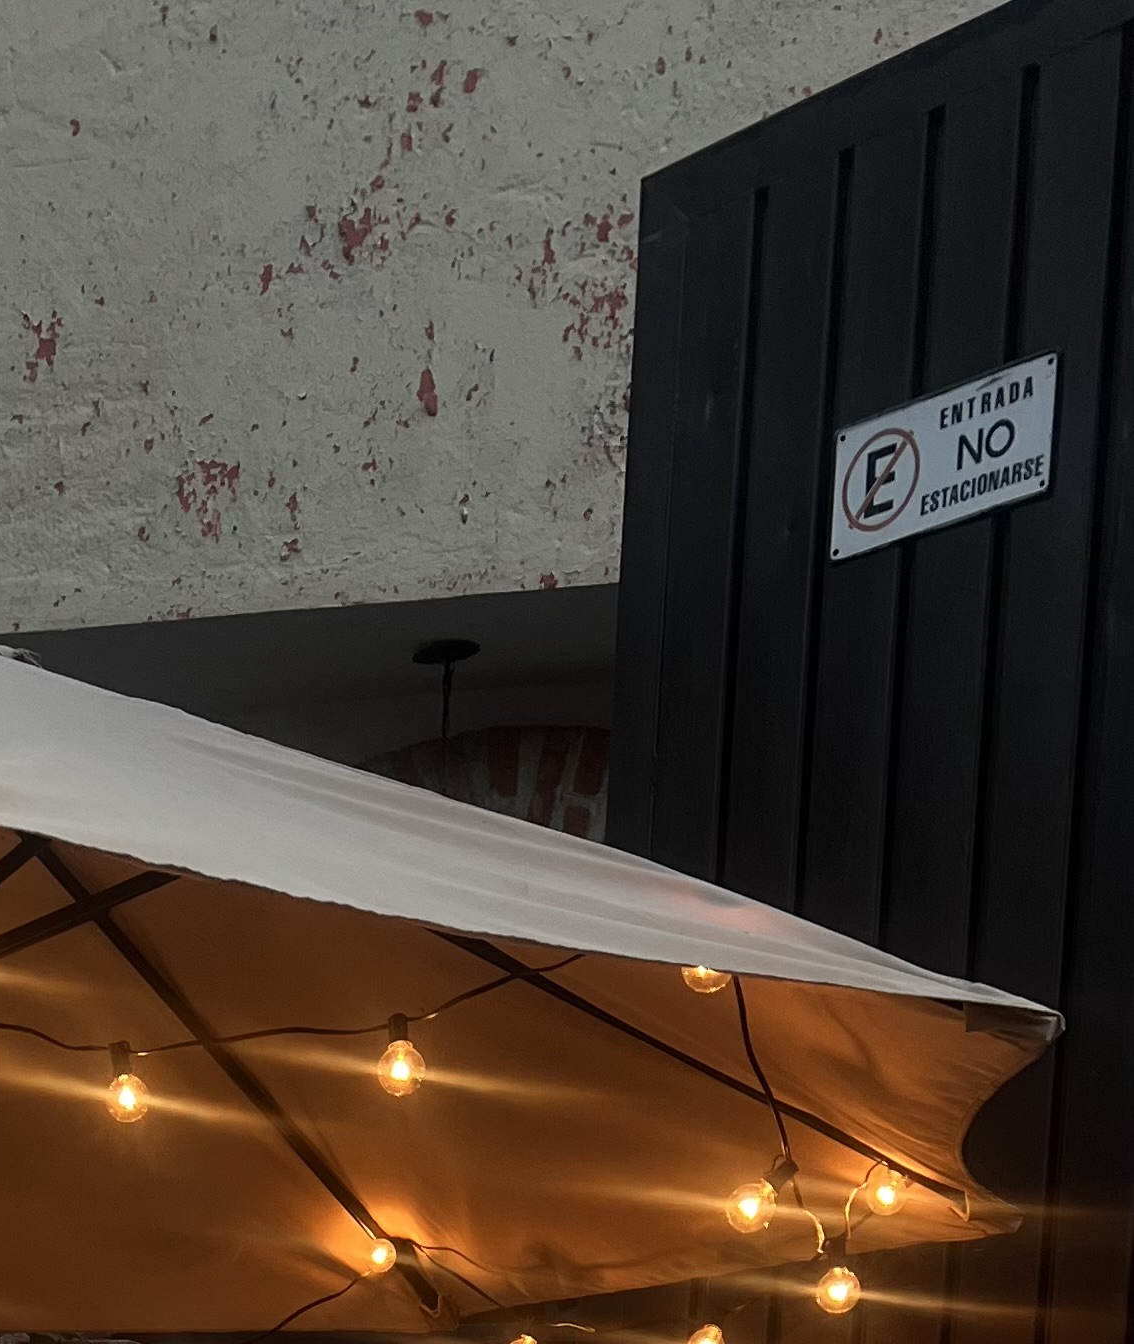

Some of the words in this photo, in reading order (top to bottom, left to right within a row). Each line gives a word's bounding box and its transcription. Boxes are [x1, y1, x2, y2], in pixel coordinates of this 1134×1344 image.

[939, 375, 1034, 430] ENTRADA
[956, 418, 1016, 471] NO
[919, 454, 1045, 516] ESTACIONARSE
